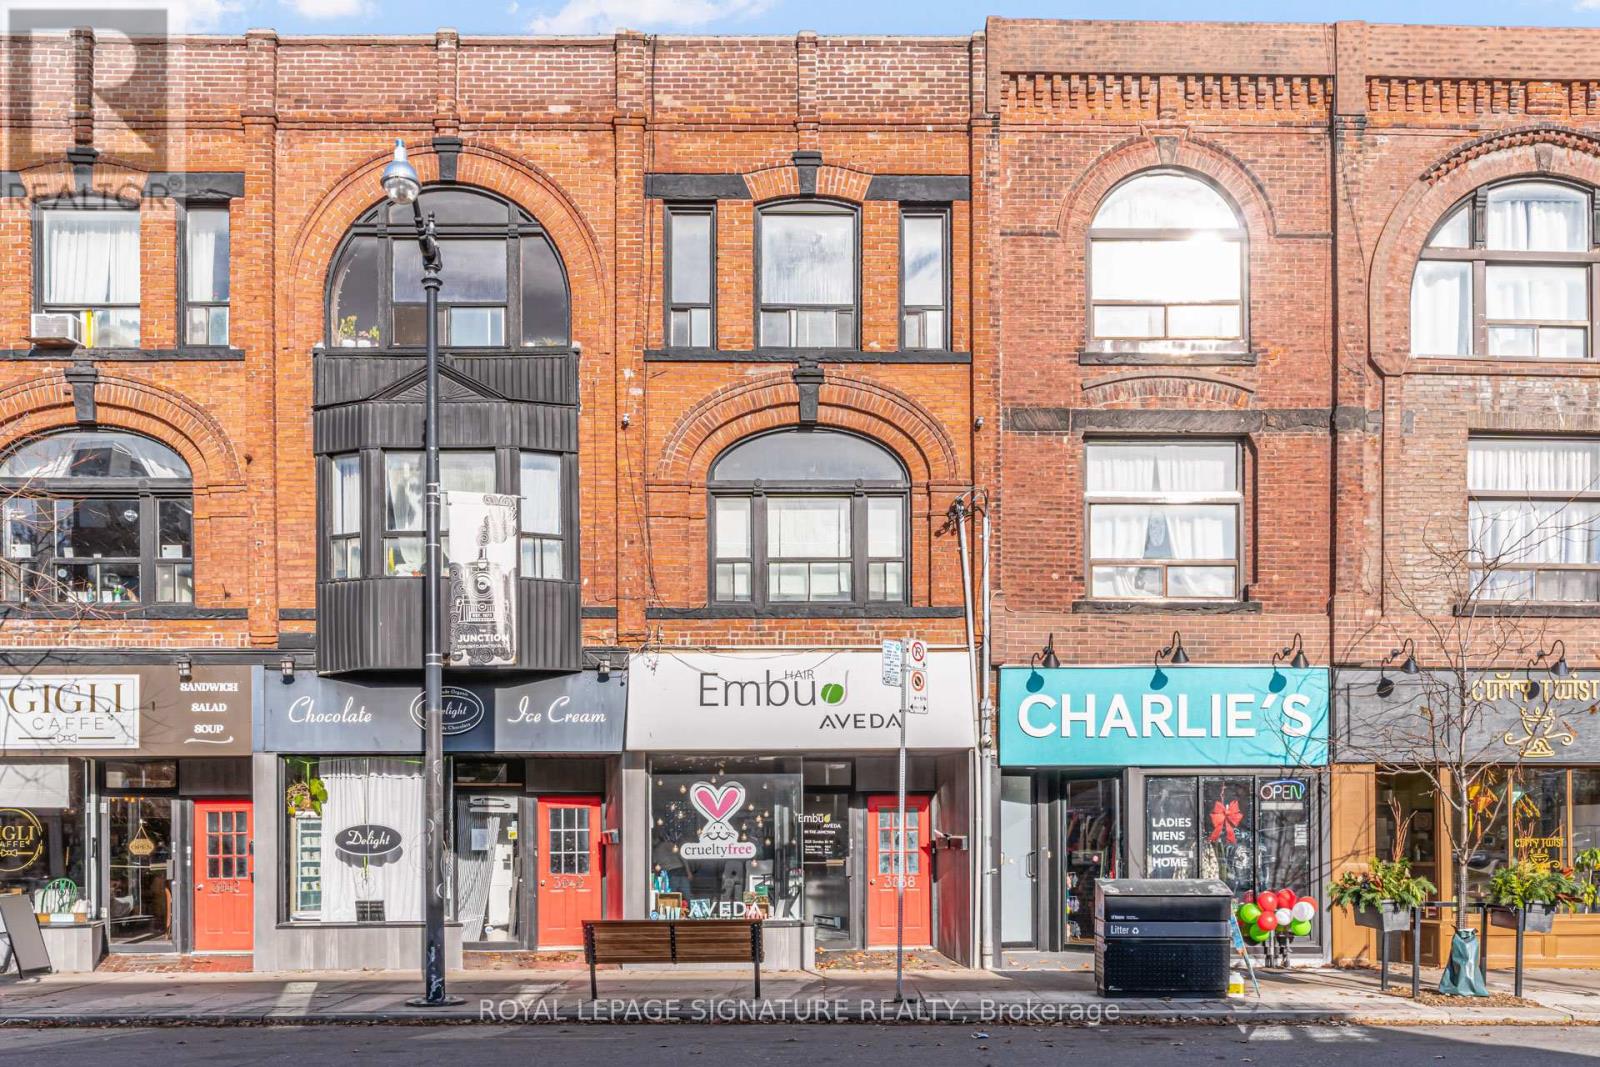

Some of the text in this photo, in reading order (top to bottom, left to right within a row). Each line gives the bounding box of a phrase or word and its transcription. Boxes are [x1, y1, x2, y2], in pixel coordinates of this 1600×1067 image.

[458, 633, 509, 642] JUNCTION
[784, 670, 814, 680] HAIR
[180, 682, 239, 692] SANDWICH
[8, 683, 124, 714] GIGLI
[191, 702, 228, 712] SALAD
[288, 695, 373, 723] Chocolate
[507, 695, 607, 723] Ice Cream
[819, 713, 901, 729] AVEDA
[1018, 694, 1312, 738] CHARLIE'S
[32, 716, 105, 730] CAFFE
[193, 724, 224, 734] SOUP
[1260, 784, 1303, 800] OPEN
[1152, 817, 1192, 828] LADIES
[346, 830, 390, 849] Delight
[1152, 831, 1186, 841] MENS
[1152, 844, 1180, 854] KIDS
[1152, 857, 1188, 868] HOME
[688, 900, 763, 917] AVEDA
[1110, 925, 1129, 935] Litter
